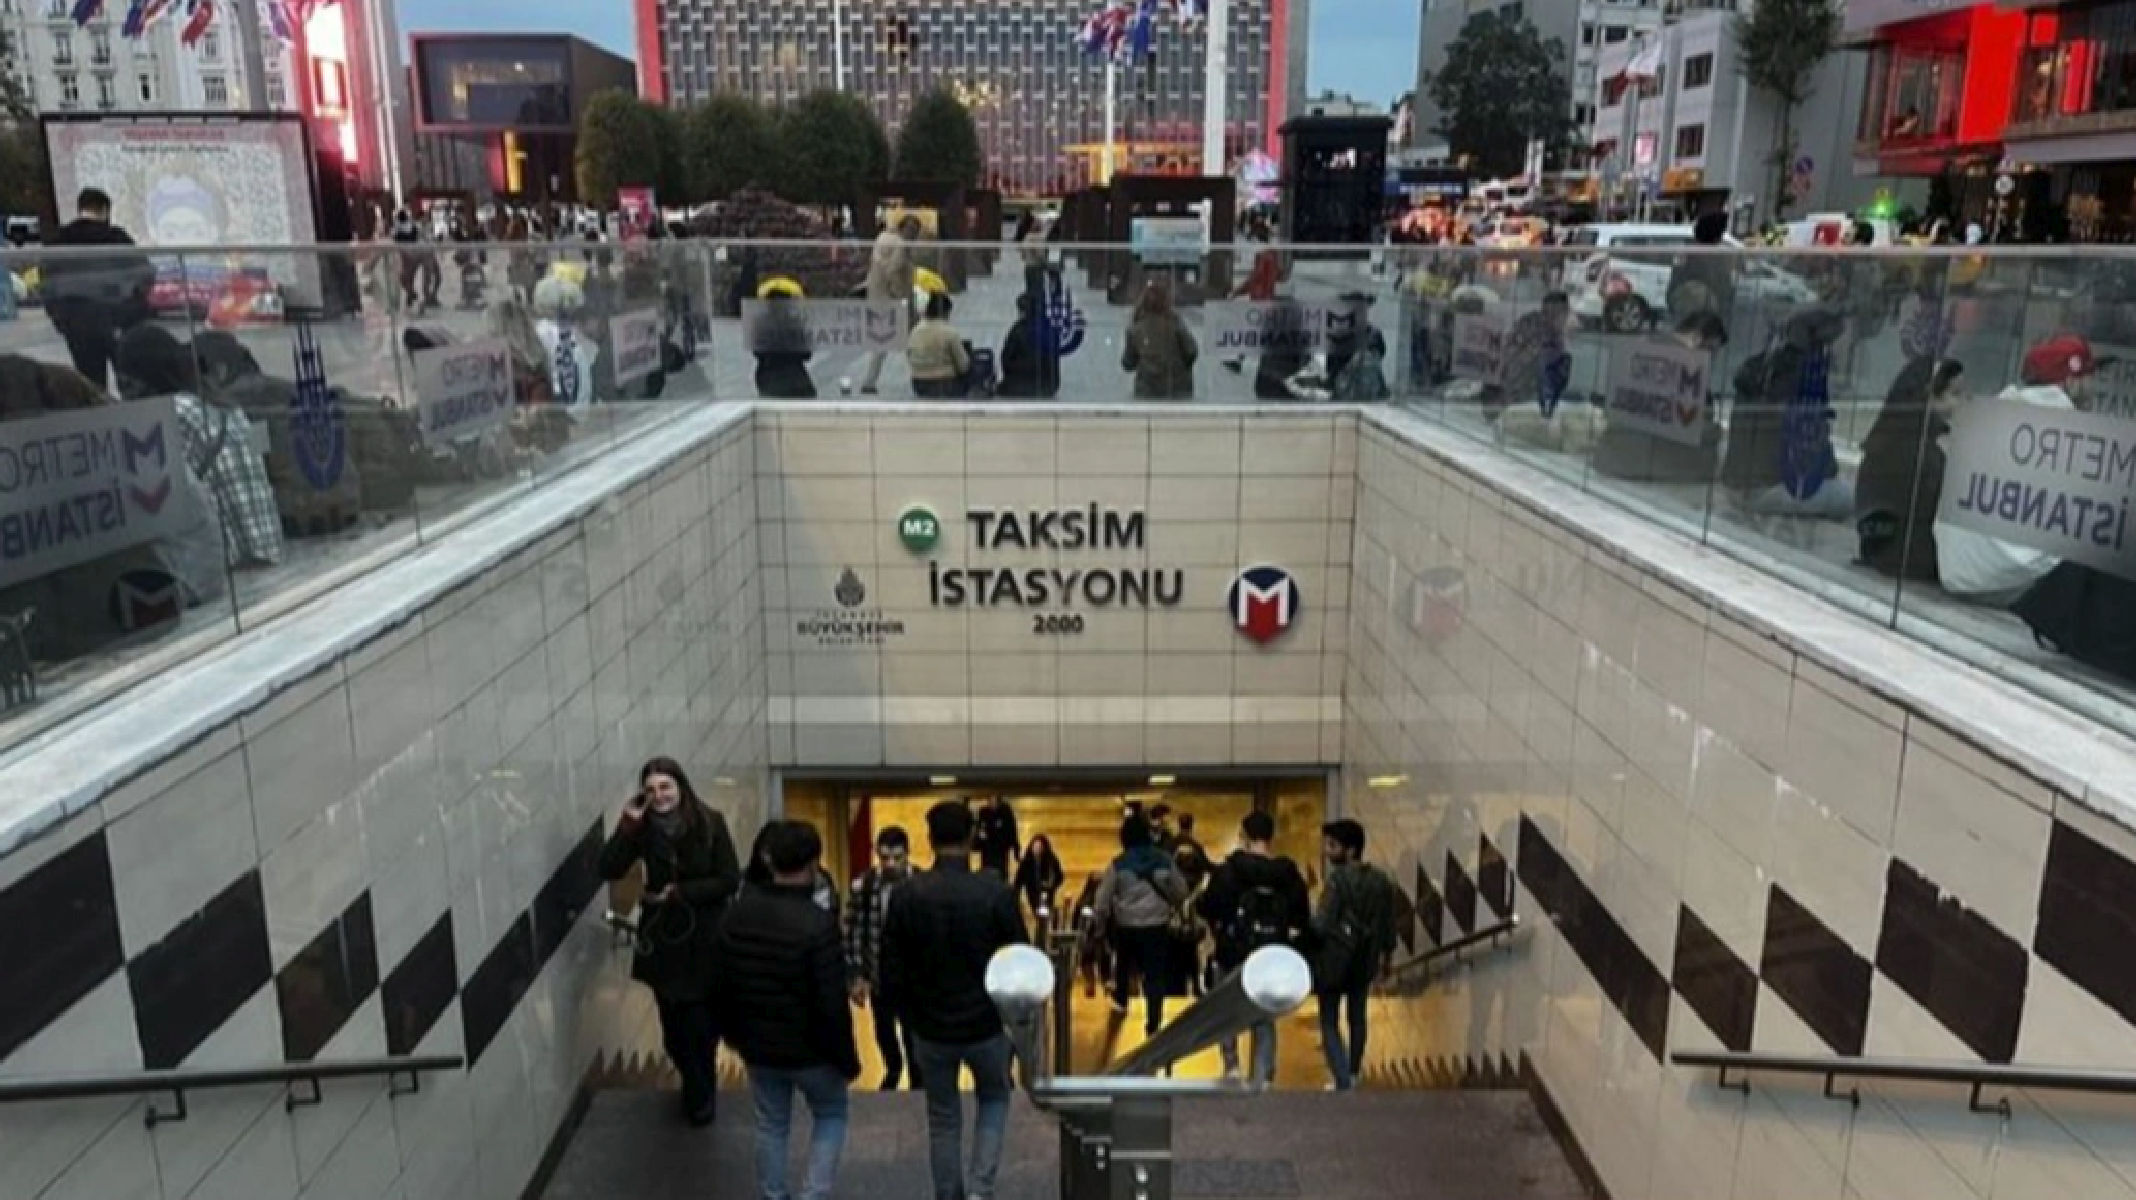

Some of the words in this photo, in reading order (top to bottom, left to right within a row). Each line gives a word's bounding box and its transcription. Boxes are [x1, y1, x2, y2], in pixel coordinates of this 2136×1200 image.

[902, 519, 936, 537] M2
[966, 502, 1145, 550] TAKSİM
[929, 561, 1184, 607] İSTASYONU
[1032, 615, 1085, 635] 2000
